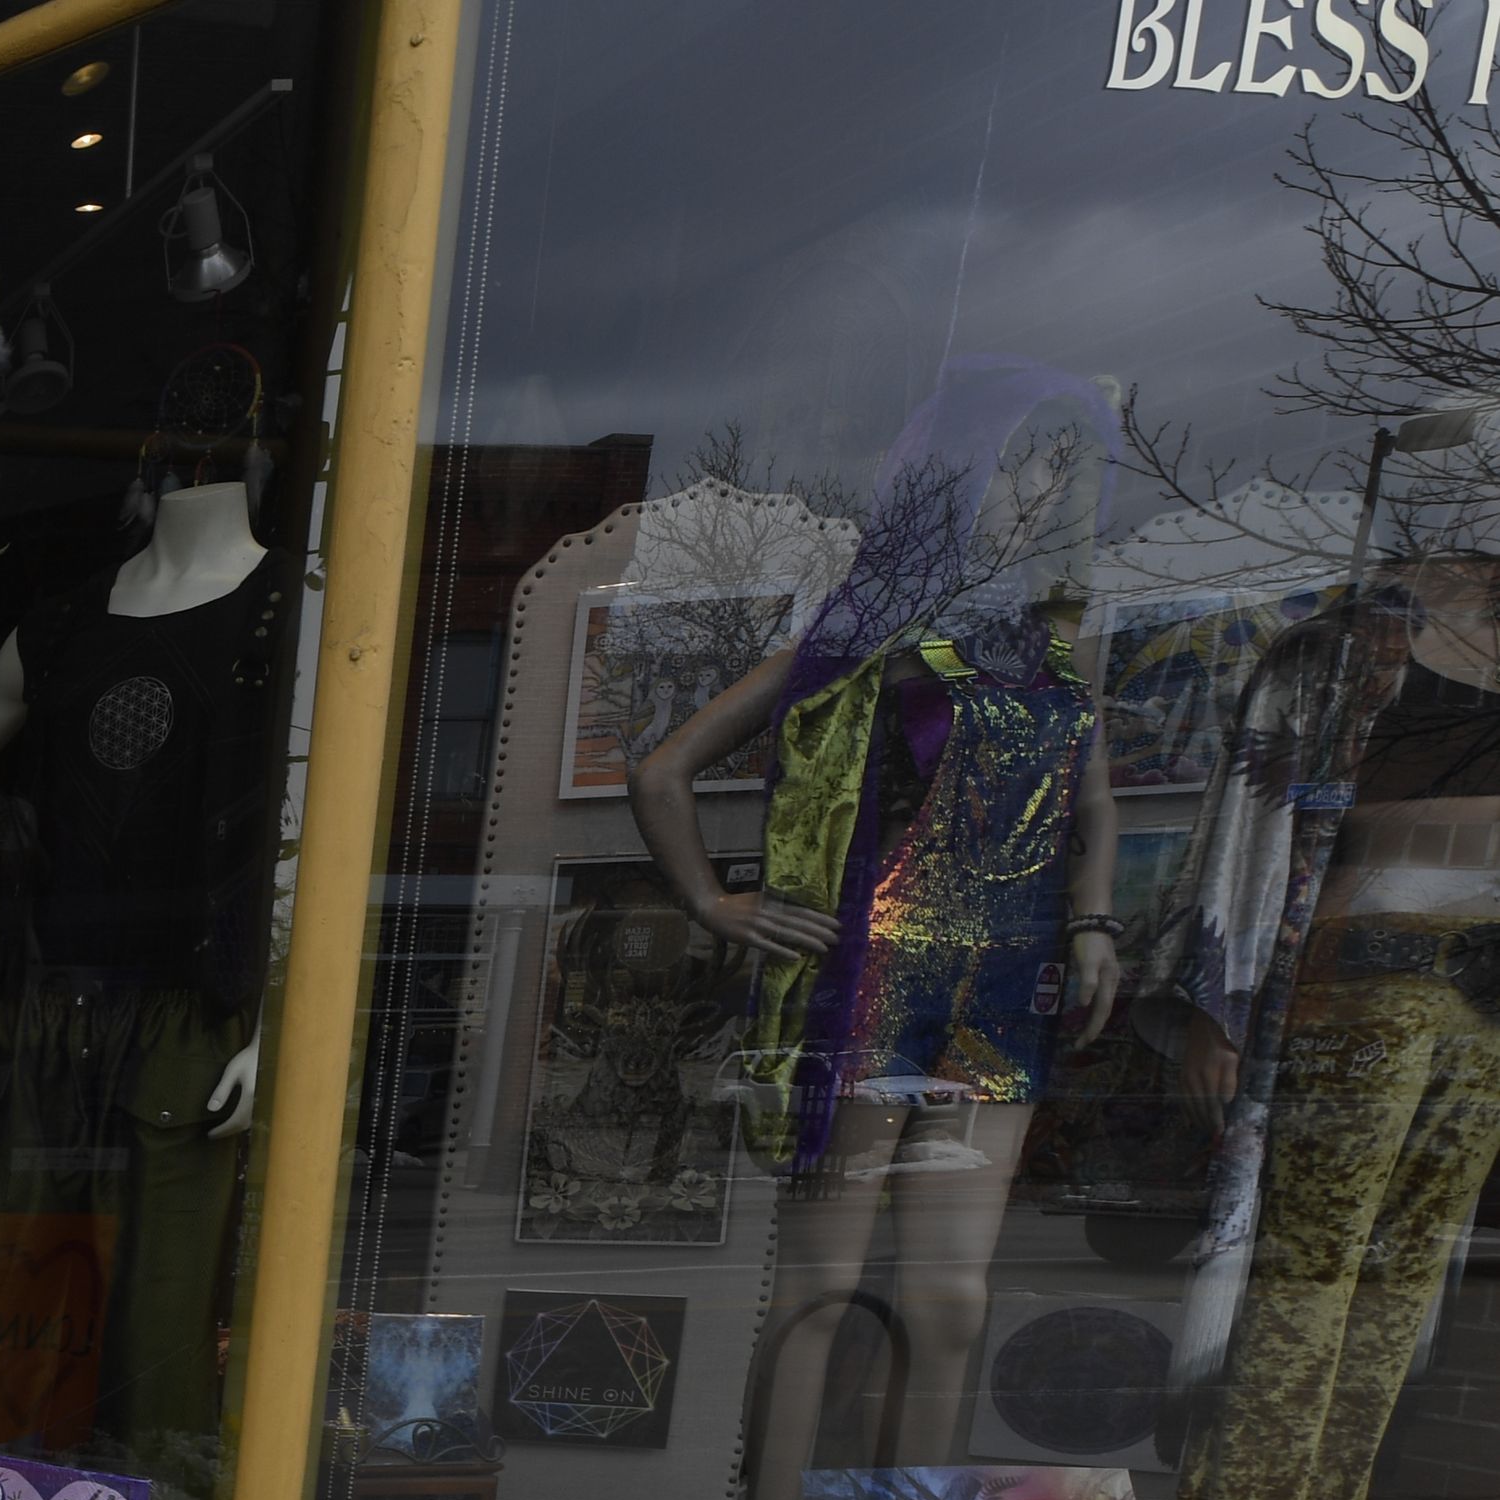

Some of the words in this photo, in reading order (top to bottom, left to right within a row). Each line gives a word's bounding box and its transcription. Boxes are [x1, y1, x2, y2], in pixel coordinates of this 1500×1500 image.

[1106, 0, 1434, 103] BLESS
[527, 1384, 593, 1402] SHINE
[602, 1388, 635, 1403] ON
